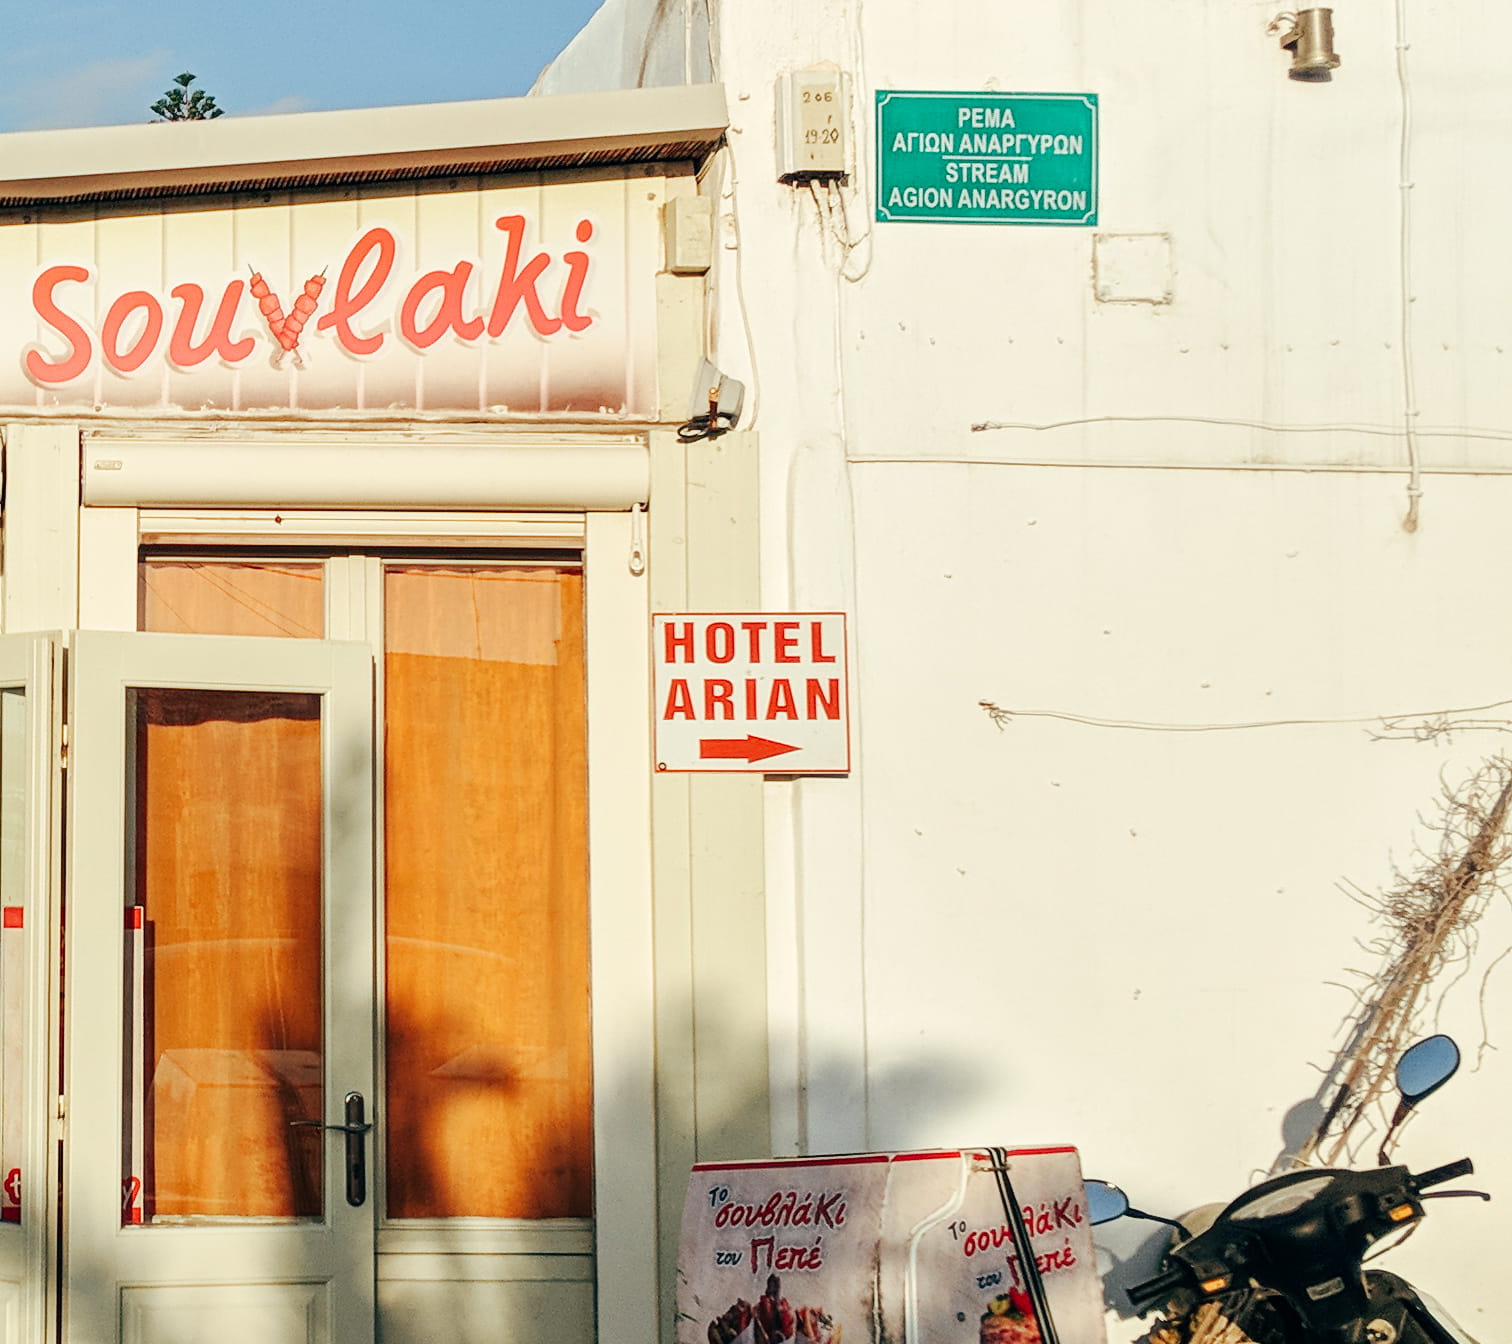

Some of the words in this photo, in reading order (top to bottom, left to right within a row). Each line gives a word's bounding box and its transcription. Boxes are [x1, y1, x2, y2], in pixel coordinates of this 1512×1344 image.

[958, 107, 1015, 129] ΡΕΜΑ
[892, 132, 954, 153] ΑΓΙΩΝ
[959, 133, 1083, 155] ΑΝΑΡΓΥΡΩΝ
[945, 162, 1029, 184] STREAM
[888, 187, 953, 208] AGION
[957, 188, 1087, 211] ANARGYRON
[26, 214, 594, 382] Souvlaki
[664, 621, 837, 664] HOTEL
[663, 678, 841, 721] ARIAN
[750, 1235, 822, 1274] Πεπέ
